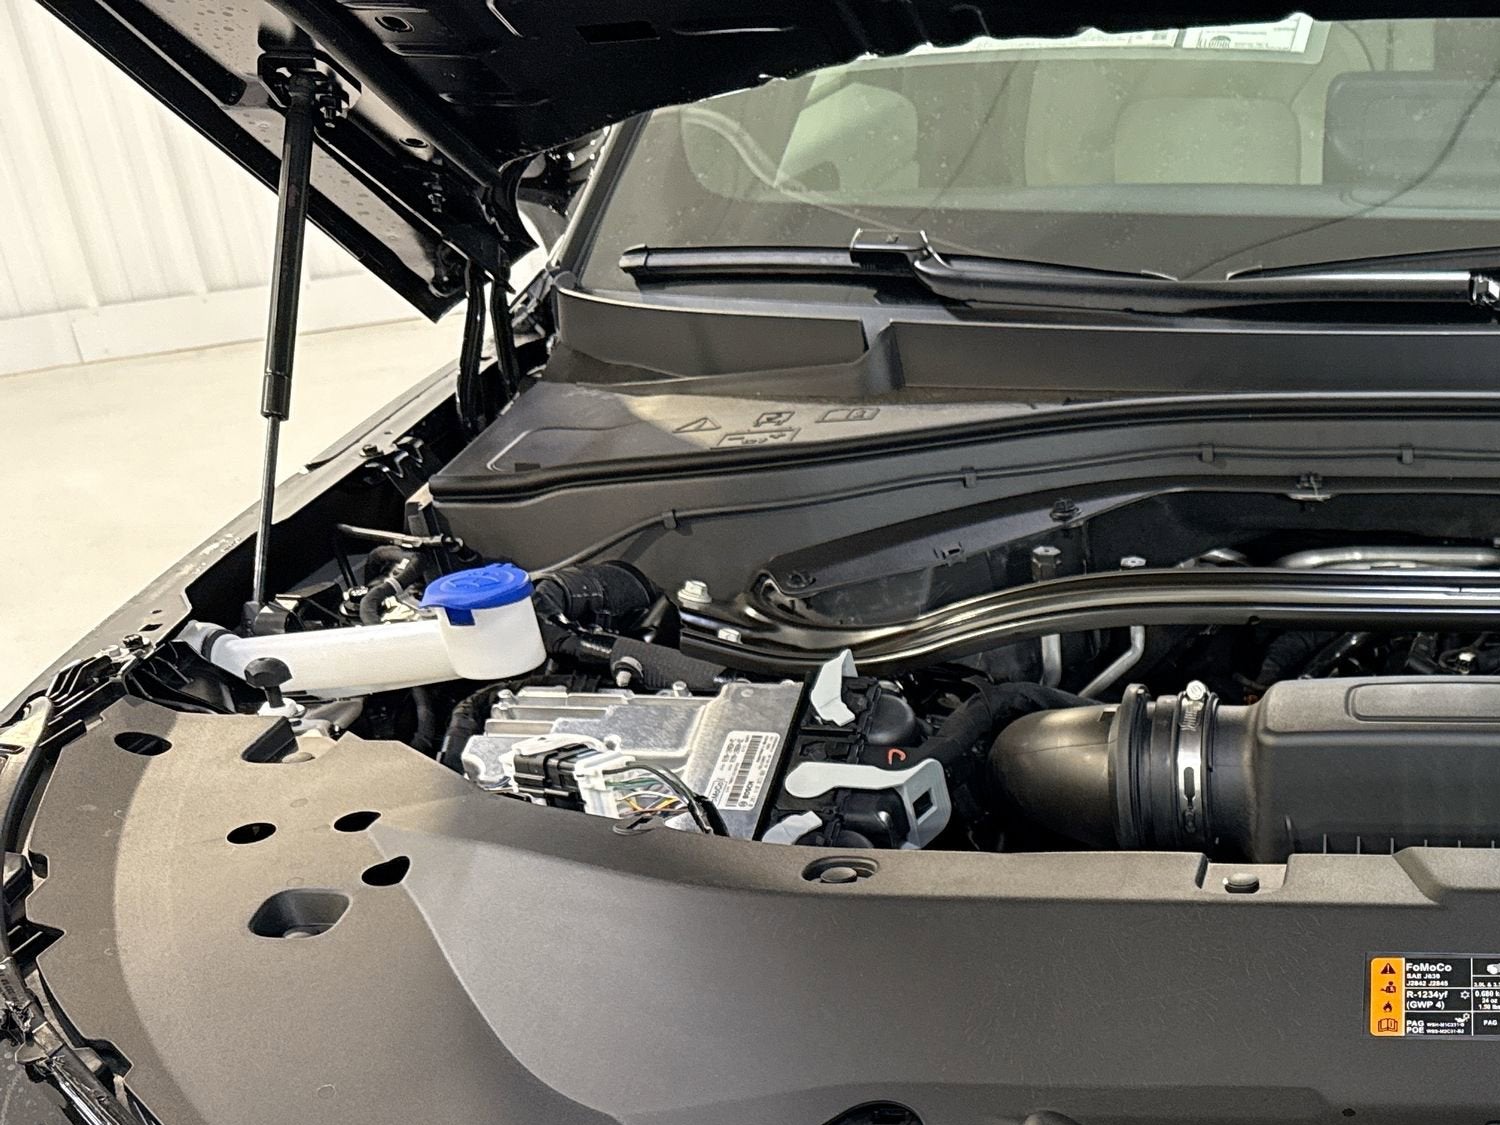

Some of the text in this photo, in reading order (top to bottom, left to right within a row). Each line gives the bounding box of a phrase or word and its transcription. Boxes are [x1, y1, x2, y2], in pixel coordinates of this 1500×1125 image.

[1406, 962, 1452, 972] FoMoCo
[1406, 990, 1448, 1000] R-1234yf
[1406, 1001, 1445, 1010] (GWP 4)
